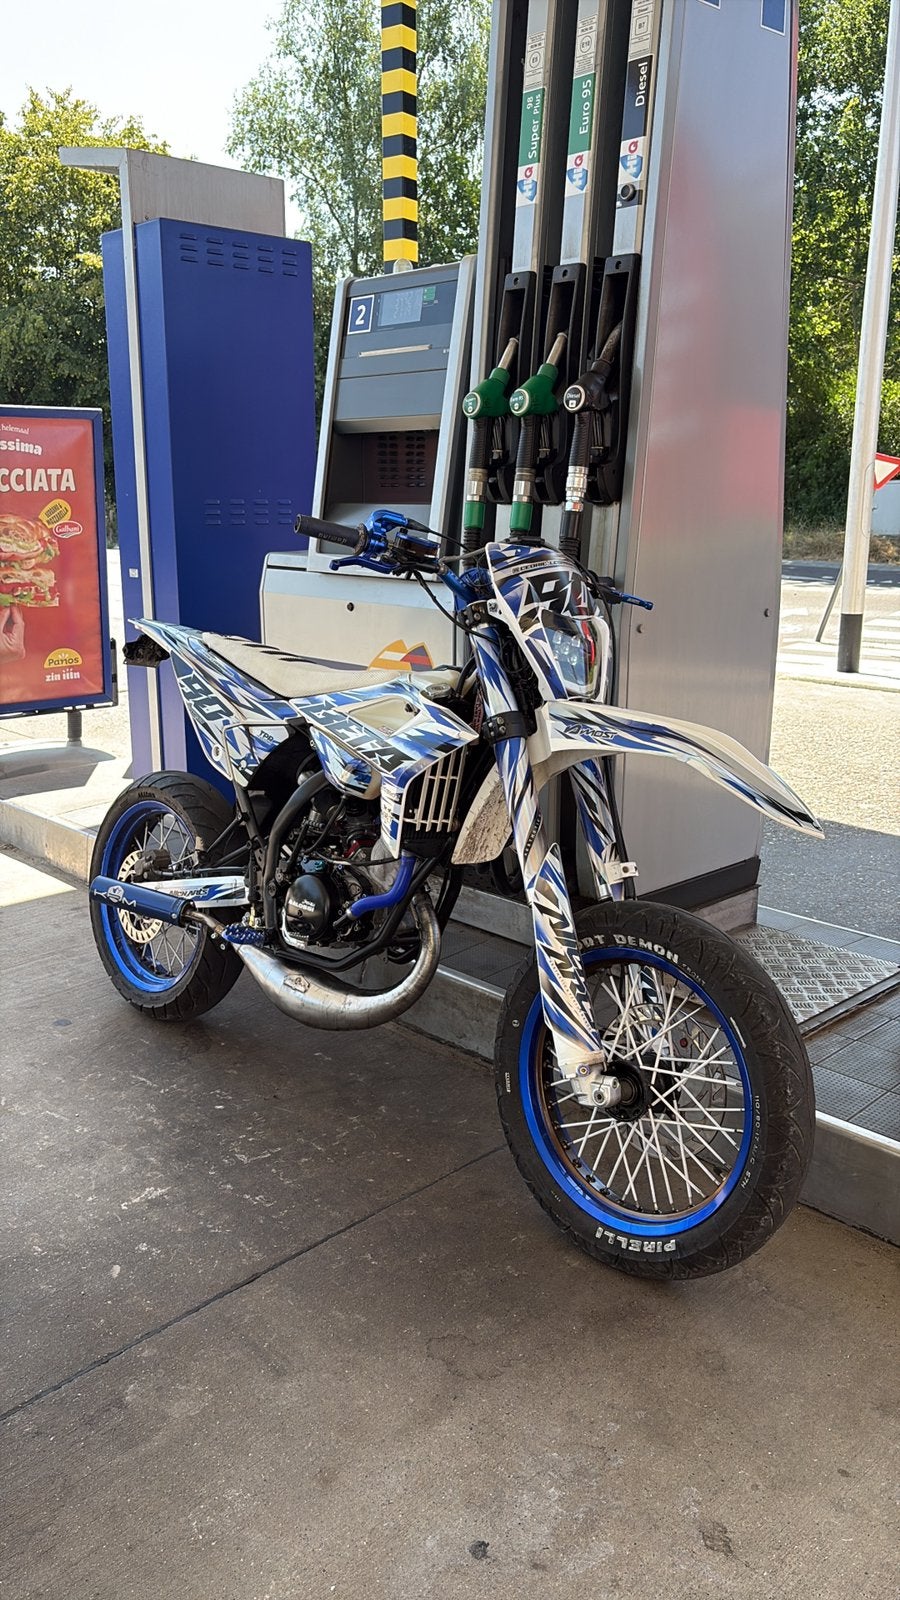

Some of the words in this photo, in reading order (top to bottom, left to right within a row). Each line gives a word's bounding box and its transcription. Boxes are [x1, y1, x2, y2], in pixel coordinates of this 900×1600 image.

[581, 79, 592, 98] 95
[635, 61, 648, 107] Diesel
[526, 96, 534, 109] 98
[579, 102, 591, 135] Euro
[528, 119, 540, 159] Super
[355, 304, 366, 326] 2
[0, 438, 43, 456] ssima
[0, 467, 76, 493] CCIATA
[56, 524, 80, 533] Galbani
[48, 657, 79, 666] Panos
[45, 672, 61, 682] zin
[300, 700, 417, 773] BETA
[613, 934, 679, 964] DEMON
[594, 1226, 677, 1253] PIRELLI
